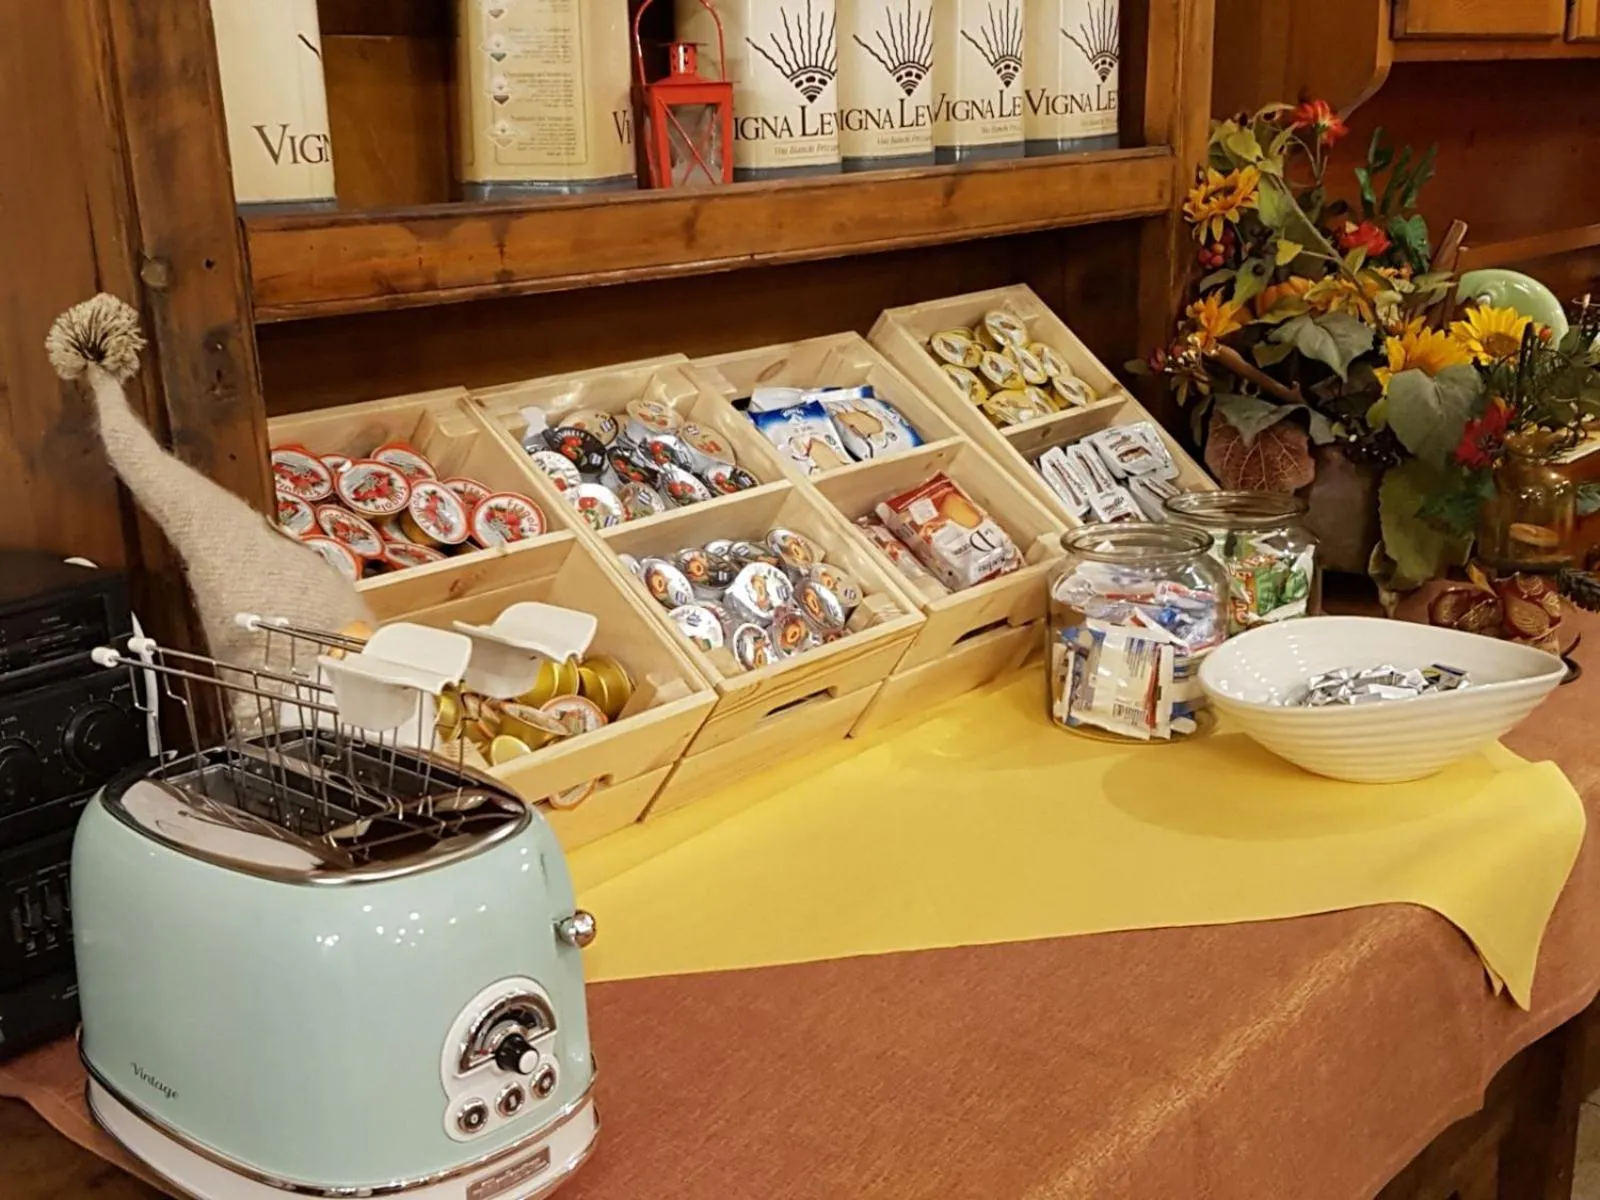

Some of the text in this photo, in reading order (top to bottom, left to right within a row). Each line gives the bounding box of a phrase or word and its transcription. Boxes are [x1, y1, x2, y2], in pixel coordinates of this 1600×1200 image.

[1025, 88, 1093, 116] VIGNA
[733, 115, 794, 141] IGNA
[839, 108, 894, 131] IGNA
[130, 1062, 179, 1099] Vintage
